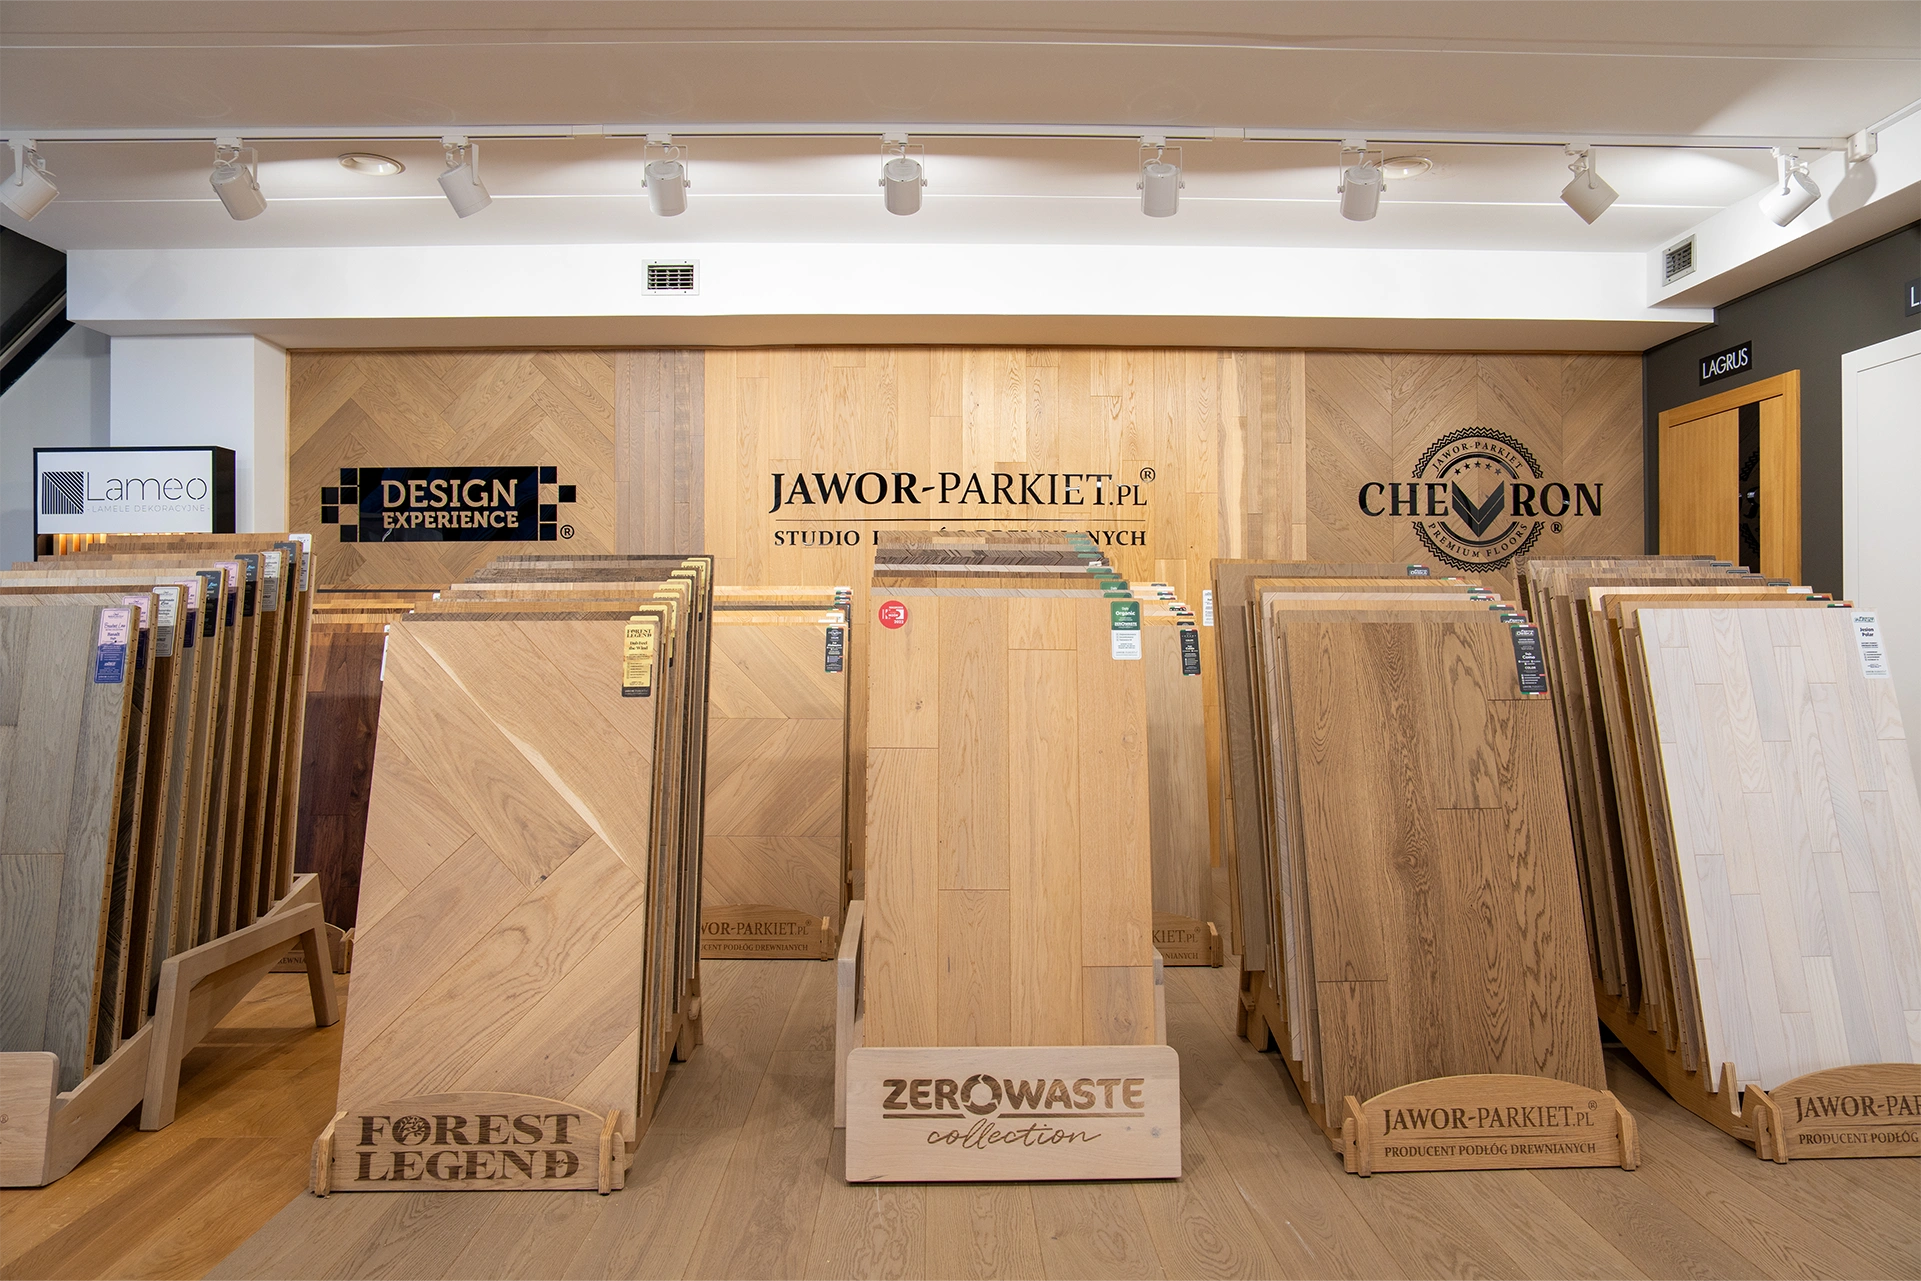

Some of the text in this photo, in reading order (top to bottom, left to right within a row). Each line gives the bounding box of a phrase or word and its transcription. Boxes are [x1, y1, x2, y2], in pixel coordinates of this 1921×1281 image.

[1702, 347, 1749, 380] LAGRUS
[1432, 441, 1523, 472] JAWOR-PARKIET
[87, 471, 208, 501] Lameo
[381, 479, 518, 508] DESIGN
[92, 504, 205, 513] LAMELE DEKORACYJNE
[382, 511, 519, 529] EXPERIENCE
[774, 530, 860, 546] STUDIO
[1428, 522, 1528, 558] PREMIUM FLOORS
[723, 943, 754, 951] PODŁÓG
[755, 943, 809, 951] DREWNIANYCH
[882, 1073, 1146, 1116] ZEROWASTE
[356, 1113, 581, 1147] FOREST
[927, 1117, 1102, 1150] collection
[1799, 1130, 1919, 1144] PRODUCENT PODŁÓG
[1384, 1142, 1596, 1158] PRODUCENT PODŁÓG DREWNIANYCH
[354, 1150, 580, 1182] LEGEND
